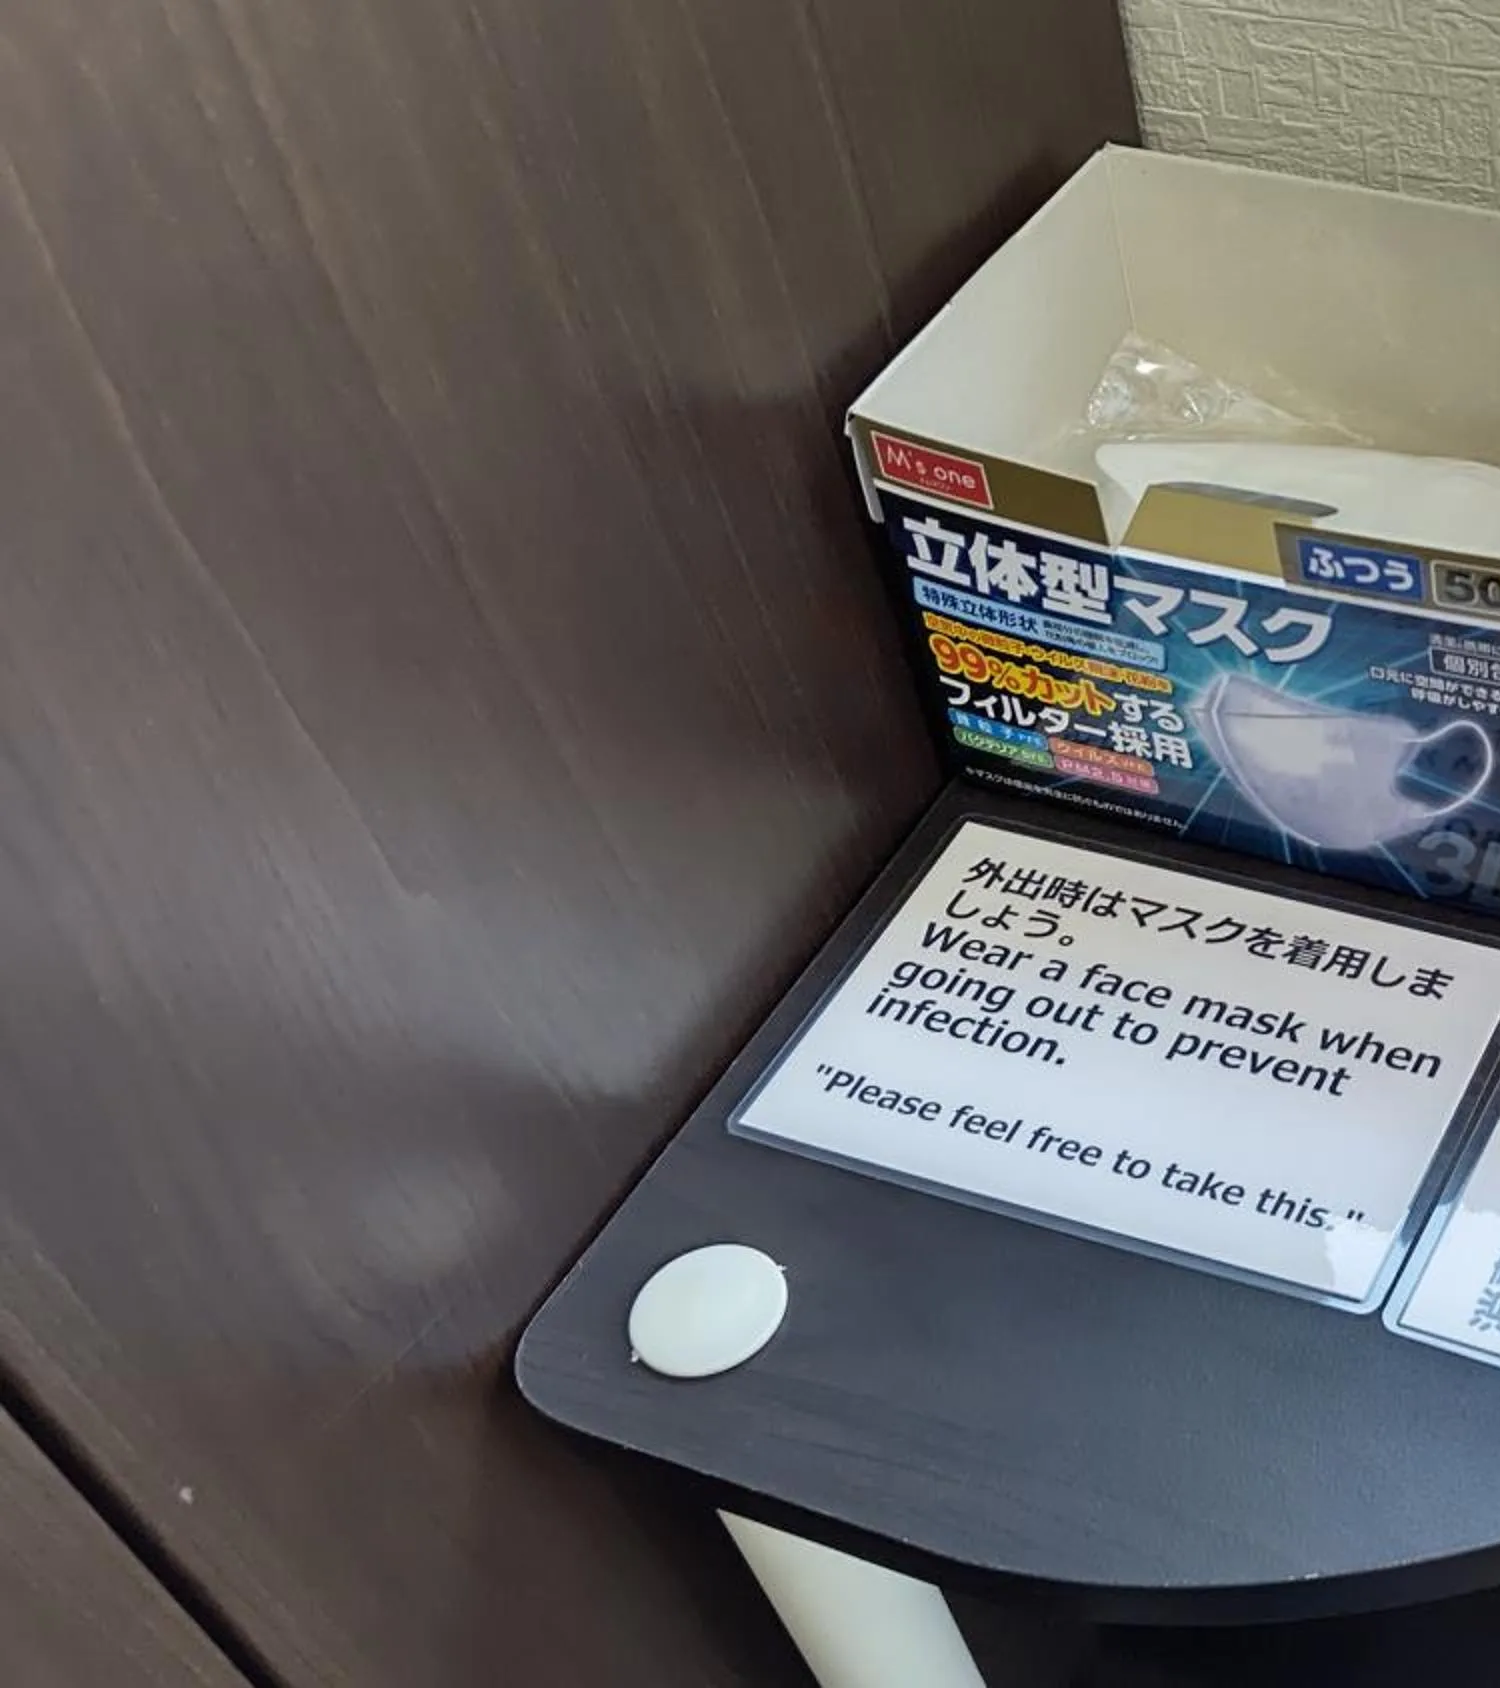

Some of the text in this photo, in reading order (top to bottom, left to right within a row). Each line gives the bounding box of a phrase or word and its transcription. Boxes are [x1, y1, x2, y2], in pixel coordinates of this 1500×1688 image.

[886, 443, 927, 475] M's
[933, 466, 976, 489] one
[903, 516, 1332, 663] 立体型マスク
[1308, 547, 1414, 591] ふつう
[938, 675, 1193, 769] フィルター採用
[945, 889, 1074, 946] しょう。
[962, 857, 1454, 999] 外出時はマスクを着用しま
[866, 987, 1066, 1065] infection.
[887, 960, 1352, 1097] going out to prevent
[921, 921, 1442, 1078] Wear a face mask when
[816, 1063, 942, 1121] "Please
[948, 1104, 1023, 1143] feel
[1026, 1126, 1103, 1166] free
[1111, 1149, 1151, 1180] to
[1160, 1162, 1245, 1205] take
